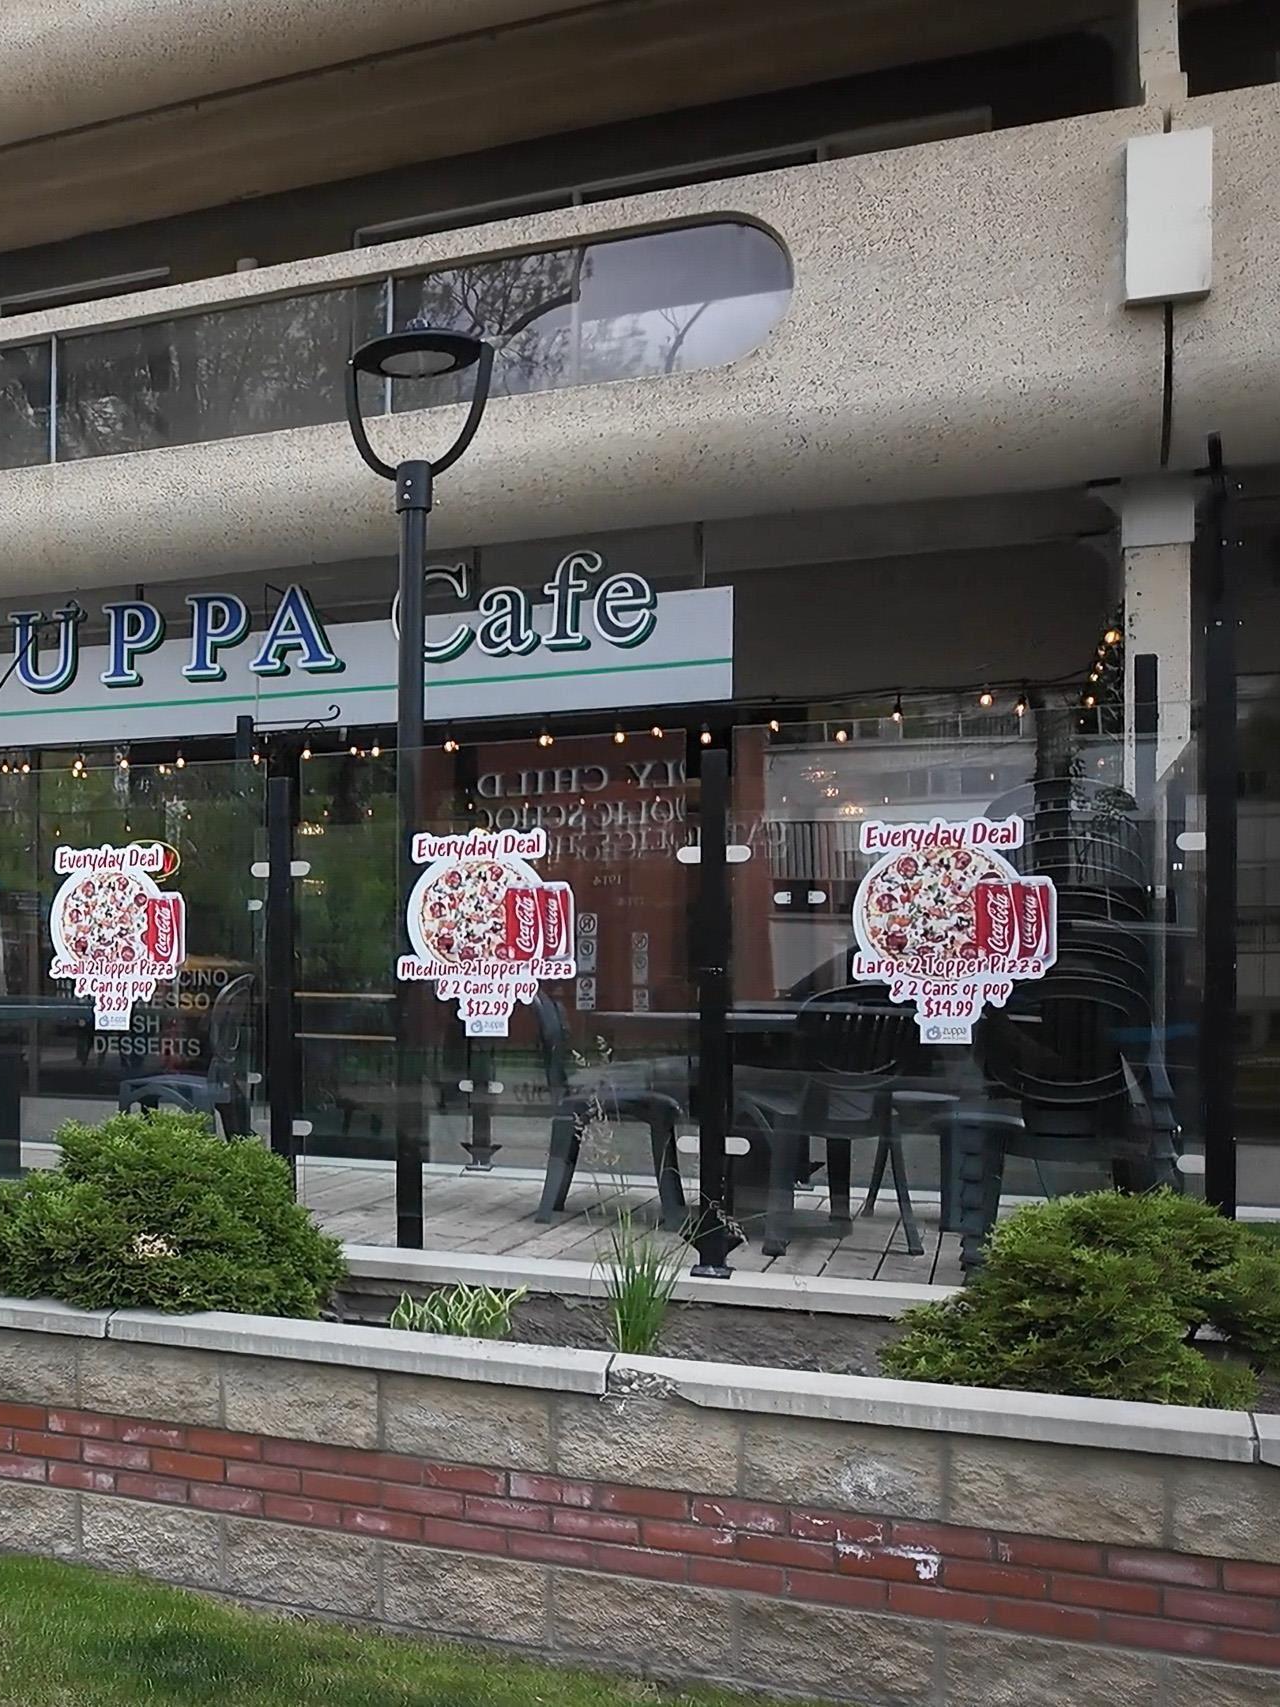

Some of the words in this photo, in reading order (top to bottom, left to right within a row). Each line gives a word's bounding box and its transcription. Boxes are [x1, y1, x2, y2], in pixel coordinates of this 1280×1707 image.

[392, 550, 657, 662] Cafe
[417, 836, 499, 860] Everyday
[503, 834, 541, 853] Deal
[865, 823, 966, 852] Everyday
[971, 821, 1017, 844] Deal
[59, 850, 125, 872] Everyday
[129, 849, 160, 867] Deal
[53, 959, 85, 975] Small
[87, 959, 95, 975] 2
[96, 959, 138, 979] Topper
[140, 959, 173, 976] Pizza
[401, 960, 460, 977] Medium
[463, 960, 473, 976] 2
[476, 960, 522, 980] Topper
[530, 959, 572, 976] Pizza
[856, 957, 906, 977] Large
[910, 958, 921, 974] 2
[925, 955, 987, 980] Topper
[990, 956, 1042, 974] Pizza
[90, 977, 113, 993] Can
[115, 981, 128, 997] of
[131, 980, 153, 998] pop
[452, 980, 460, 994] 2
[463, 979, 494, 994] Cans
[497, 981, 510, 998] of
[514, 981, 537, 999] pop
[908, 981, 917, 996] 2
[922, 980, 958, 997] Cans
[962, 983, 978, 1000] of
[983, 982, 1010, 1000] pop
[97, 993, 129, 1012] $9.99
[465, 997, 509, 1017] $12.99
[922, 996, 973, 1018] $14.99
[93, 1036, 201, 1057] DESSERTS
